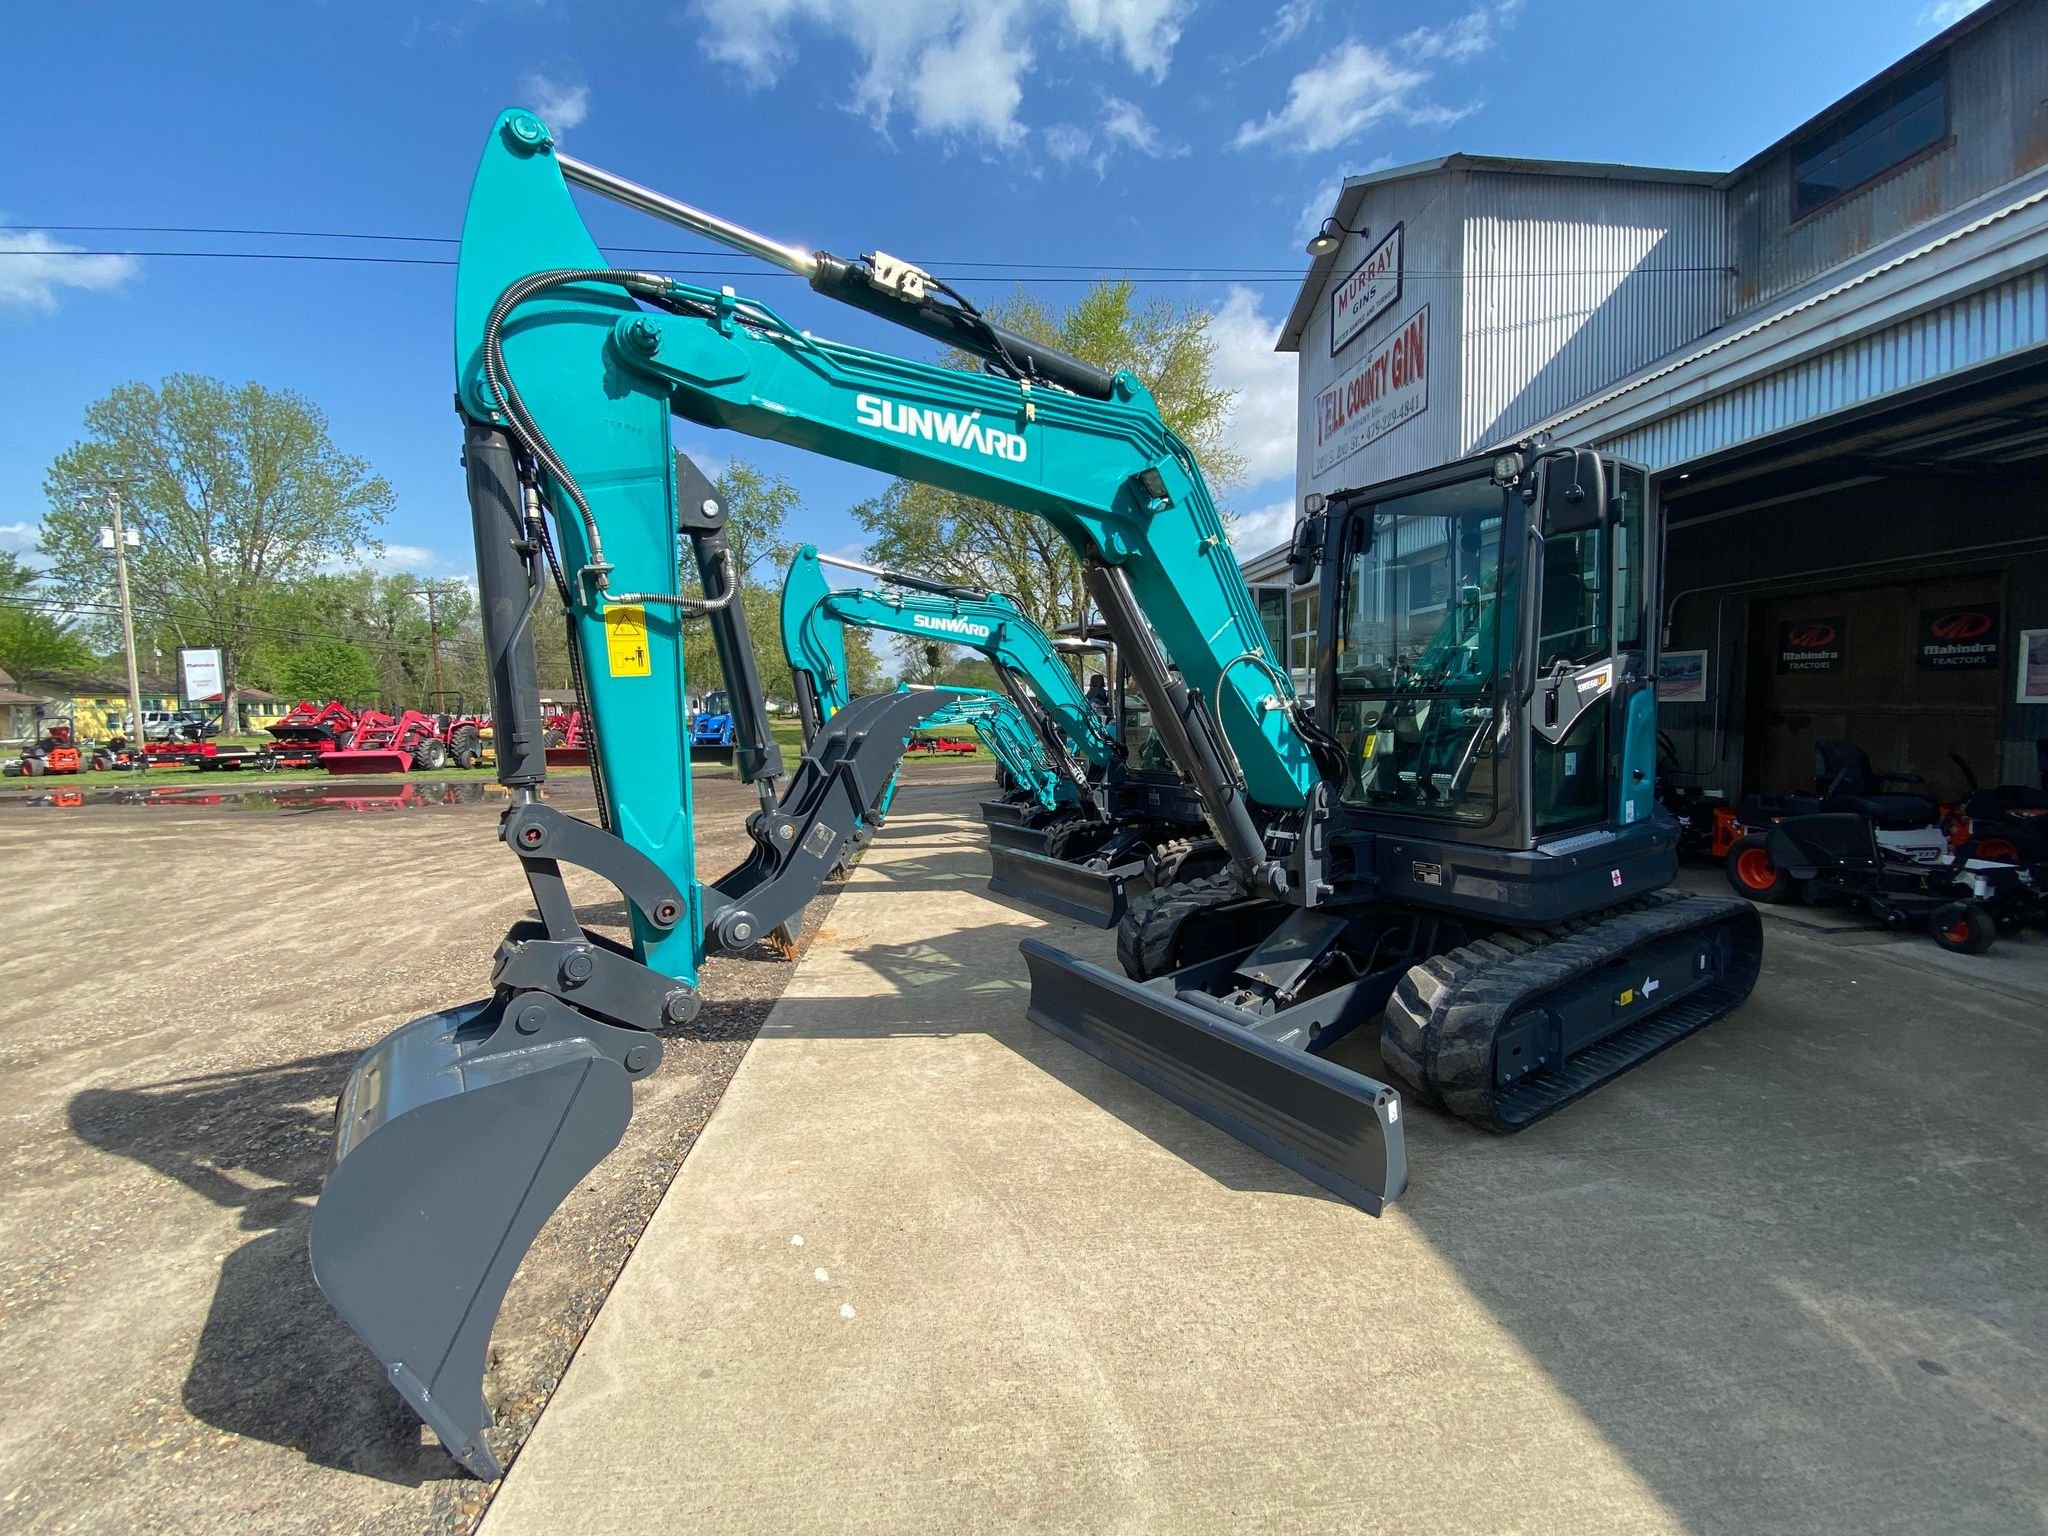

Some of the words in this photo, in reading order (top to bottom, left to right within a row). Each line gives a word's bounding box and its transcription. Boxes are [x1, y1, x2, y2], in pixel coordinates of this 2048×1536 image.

[1338, 241, 1394, 317] MURRAY
[1352, 284, 1377, 315] GINS
[1366, 304, 1376, 318] AND
[1316, 387, 1345, 447] YELL
[1346, 349, 1389, 418] COUNTY
[1391, 312, 1424, 391] GIN
[856, 393, 1027, 463] SUNWARD
[913, 613, 990, 637] SUNWARD
[1782, 650, 1838, 661] Mahindra
[1923, 643, 1996, 655] Mahindra
[1789, 661, 1831, 669] TRACTORS
[1932, 655, 1987, 665] TRACTORS
